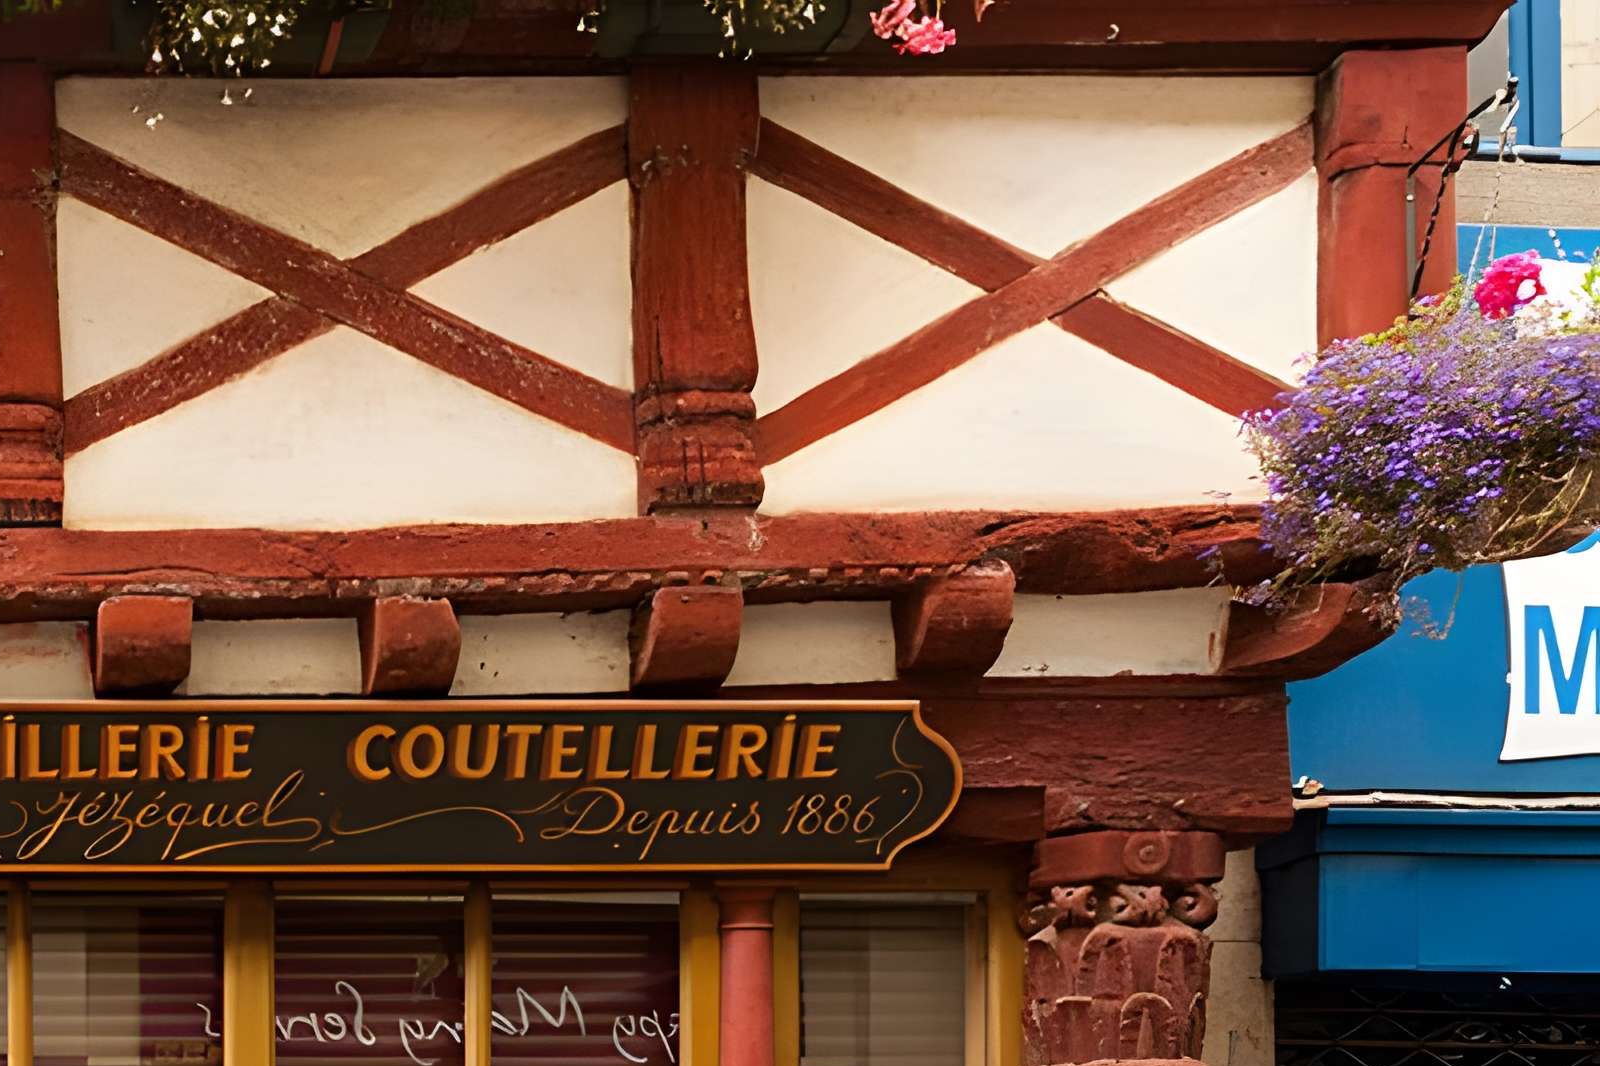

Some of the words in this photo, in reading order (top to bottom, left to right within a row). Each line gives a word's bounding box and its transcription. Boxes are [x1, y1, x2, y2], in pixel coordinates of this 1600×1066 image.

[347, 713, 842, 784] COUTELLERIE
[16, 770, 308, 861] Jézéquel
[539, 786, 762, 861] Depuis
[781, 793, 881, 835] 1886
